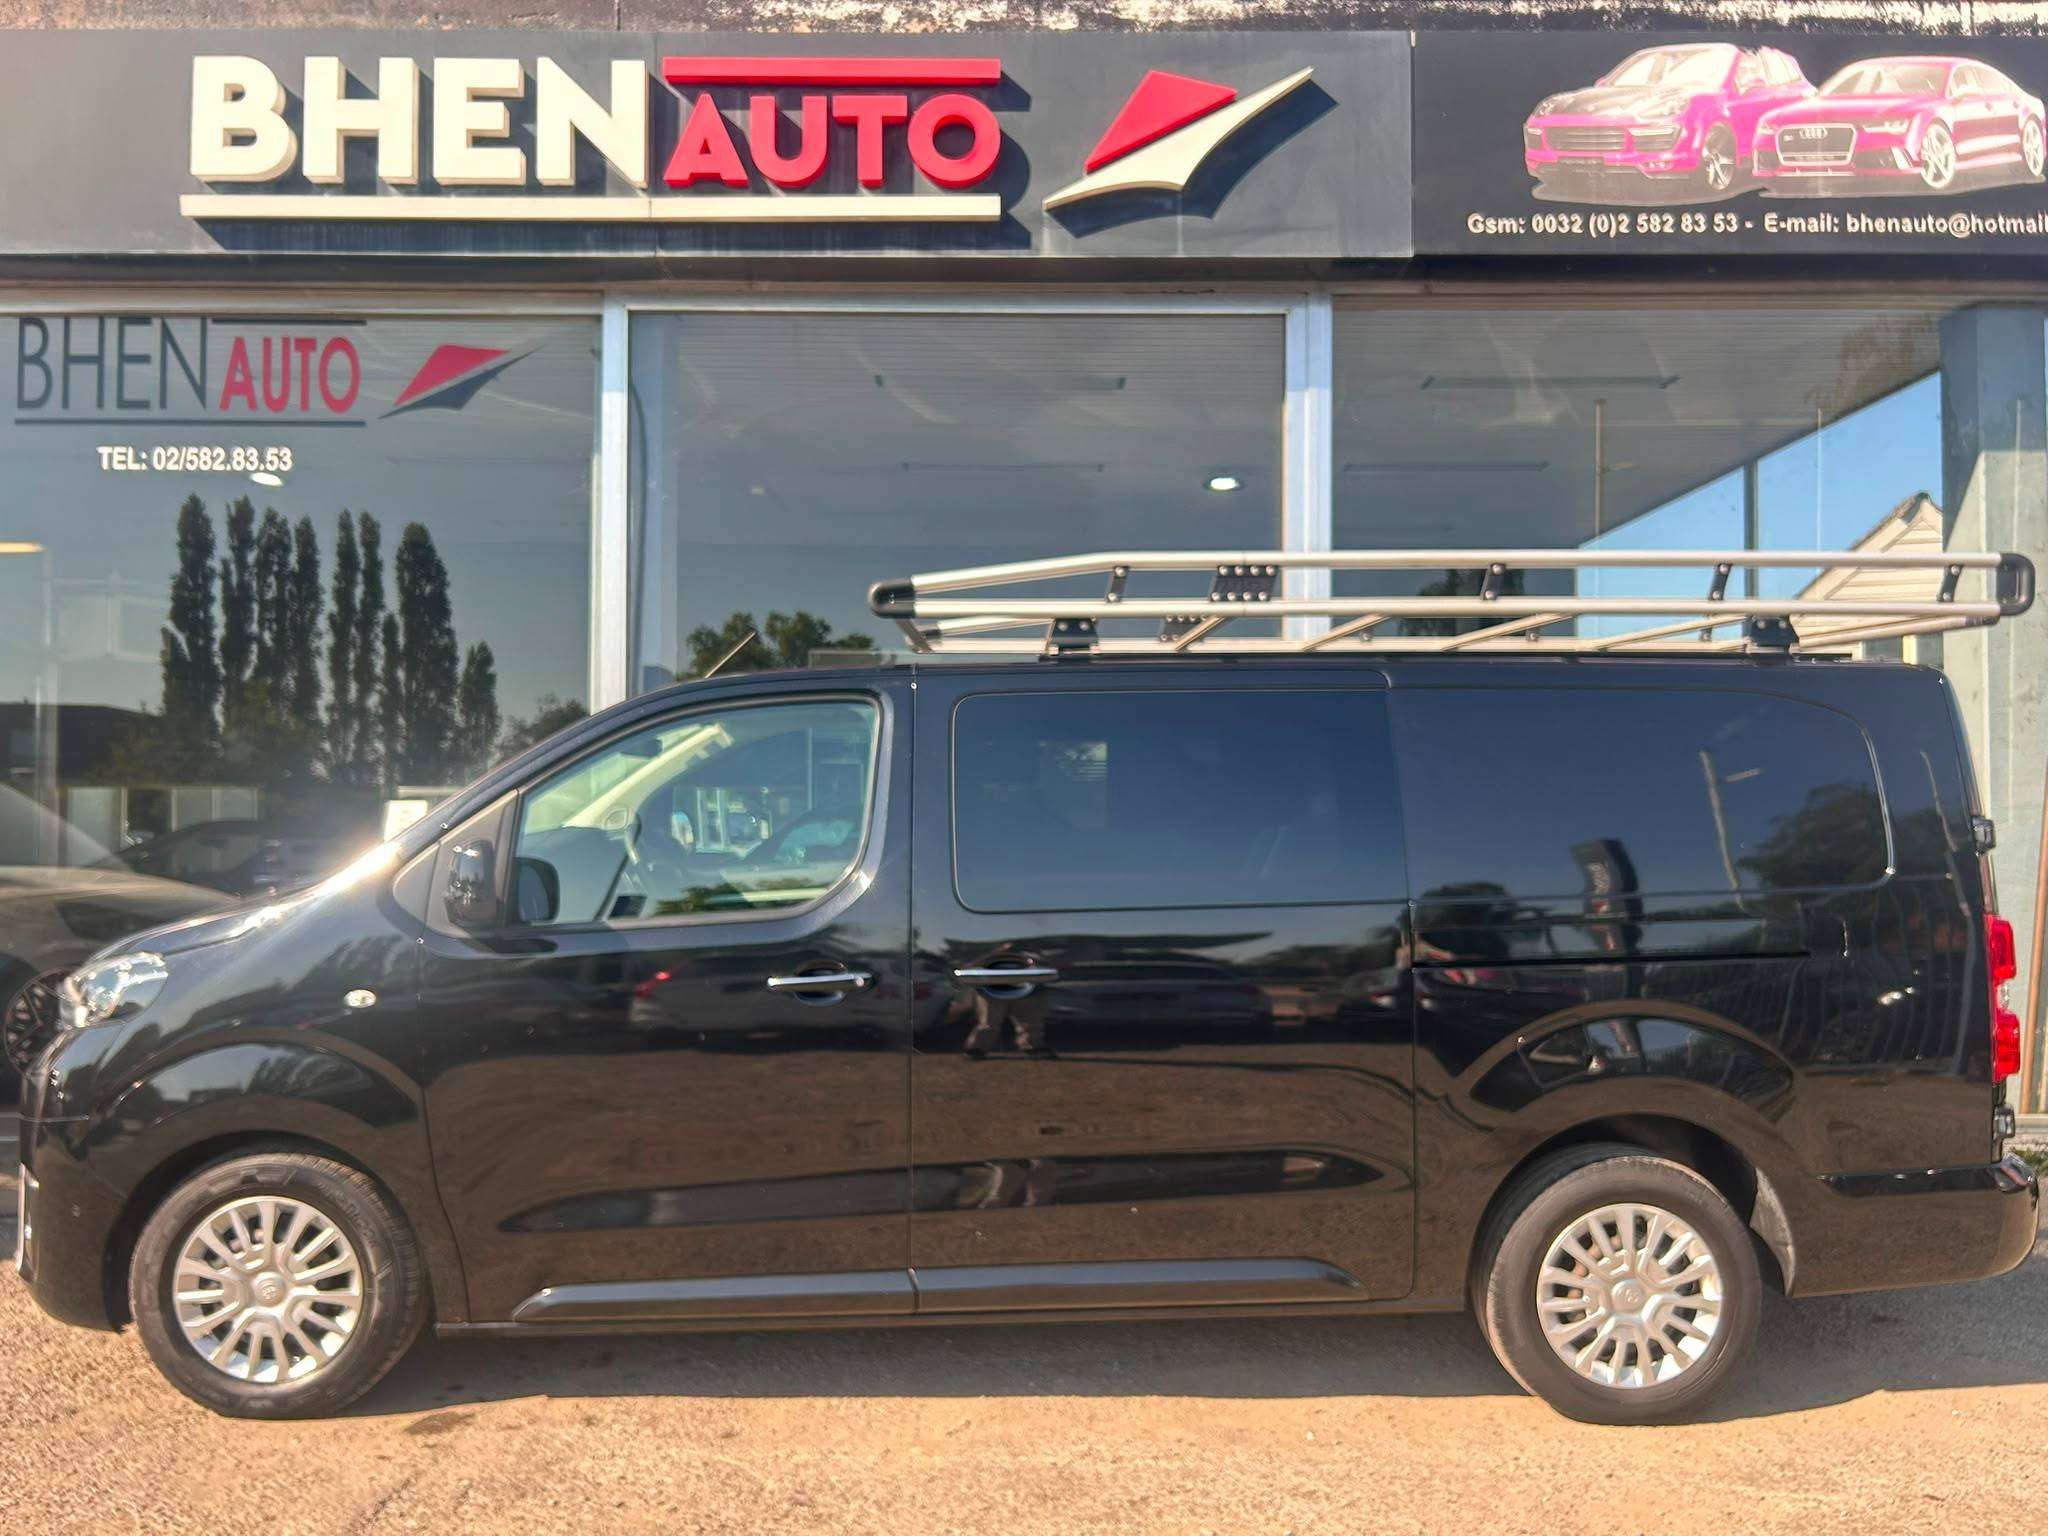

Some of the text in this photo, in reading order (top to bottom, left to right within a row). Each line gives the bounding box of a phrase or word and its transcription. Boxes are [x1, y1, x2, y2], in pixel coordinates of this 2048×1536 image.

[190, 56, 1001, 189] BHEN AUTO
[1467, 213, 1525, 234] Gsm:
[1531, 213, 1583, 233] 0032
[1589, 213, 1630, 238] (0)2
[1636, 213, 1674, 233] 582
[1680, 213, 1706, 233] 83
[1713, 213, 1738, 233] 53
[1764, 212, 1839, 233] E-mail:
[17, 317, 361, 414] BHEN AUTO
[98, 446, 292, 472] TEL: 02/582.83.53
